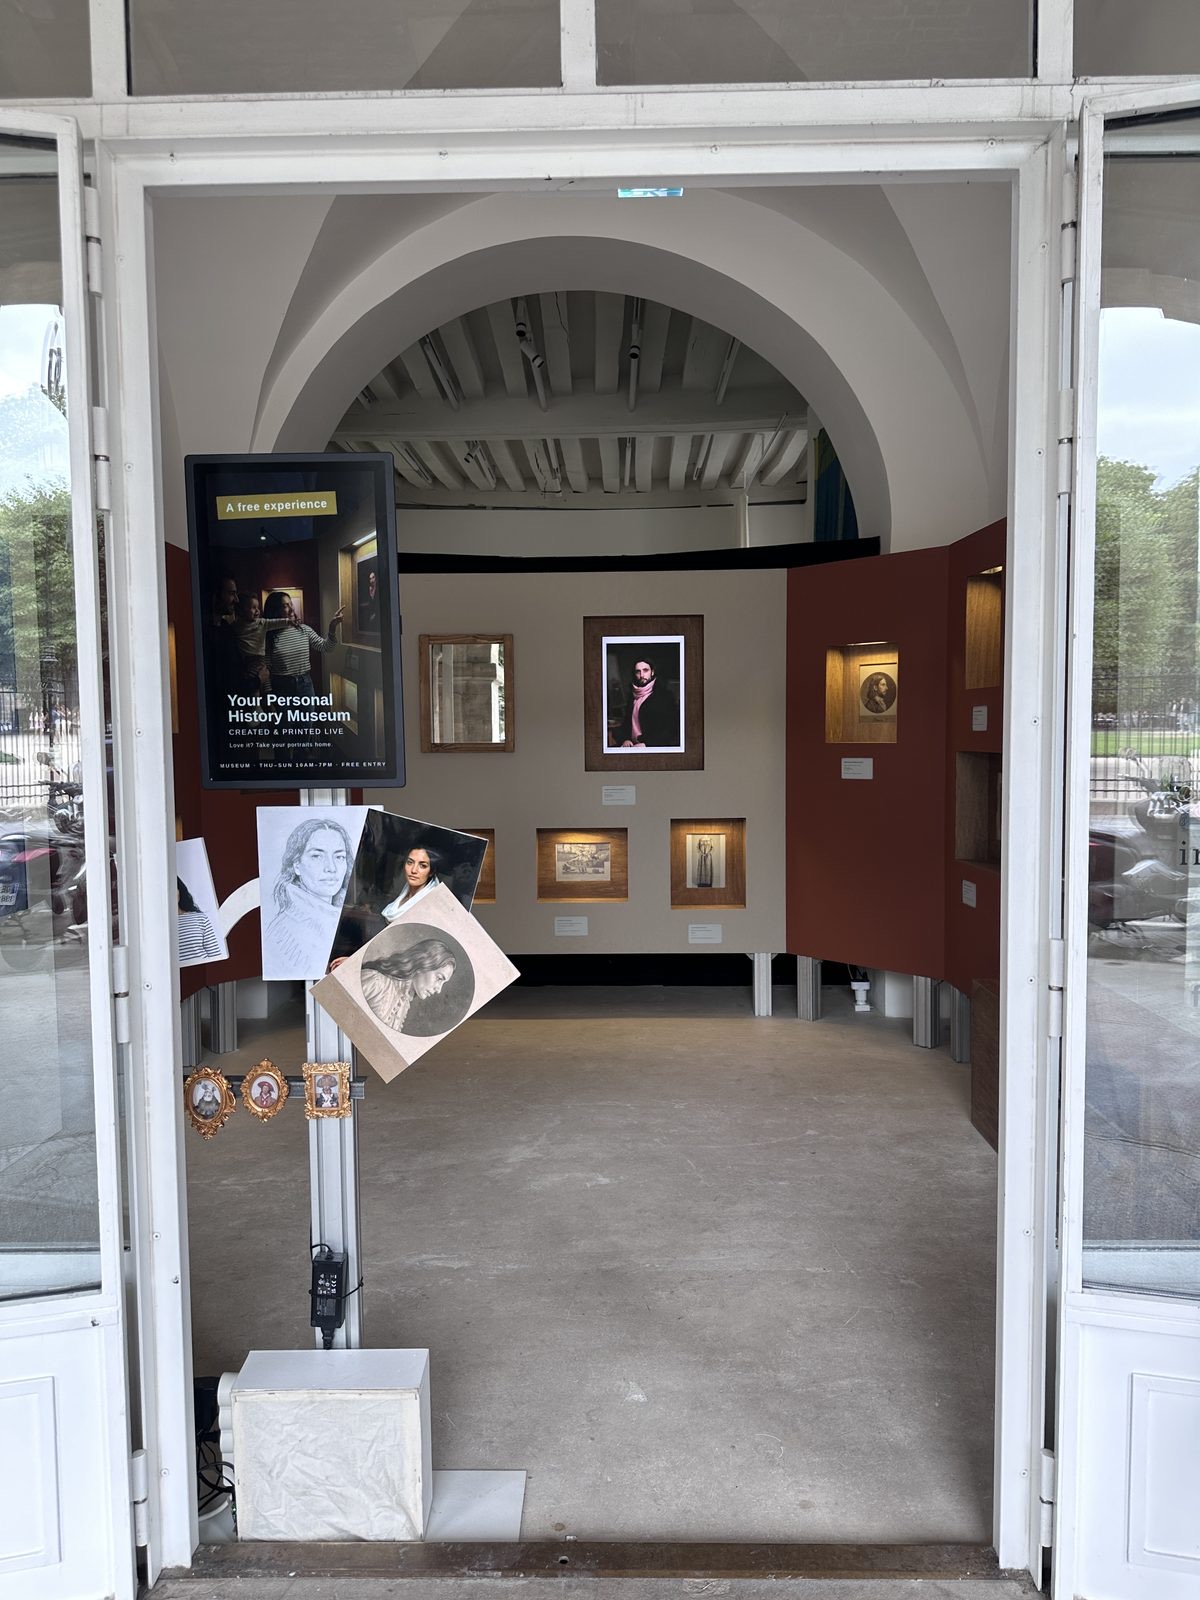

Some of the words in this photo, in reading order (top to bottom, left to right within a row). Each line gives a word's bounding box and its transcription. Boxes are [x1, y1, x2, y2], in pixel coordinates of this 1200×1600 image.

[226, 503, 234, 512] A
[237, 502, 260, 512] free
[264, 500, 328, 512] experience
[227, 694, 262, 706] Your
[266, 694, 333, 706] Personal
[228, 710, 282, 724] History
[287, 710, 350, 722] Museum
[287, 741, 313, 749] portraits
